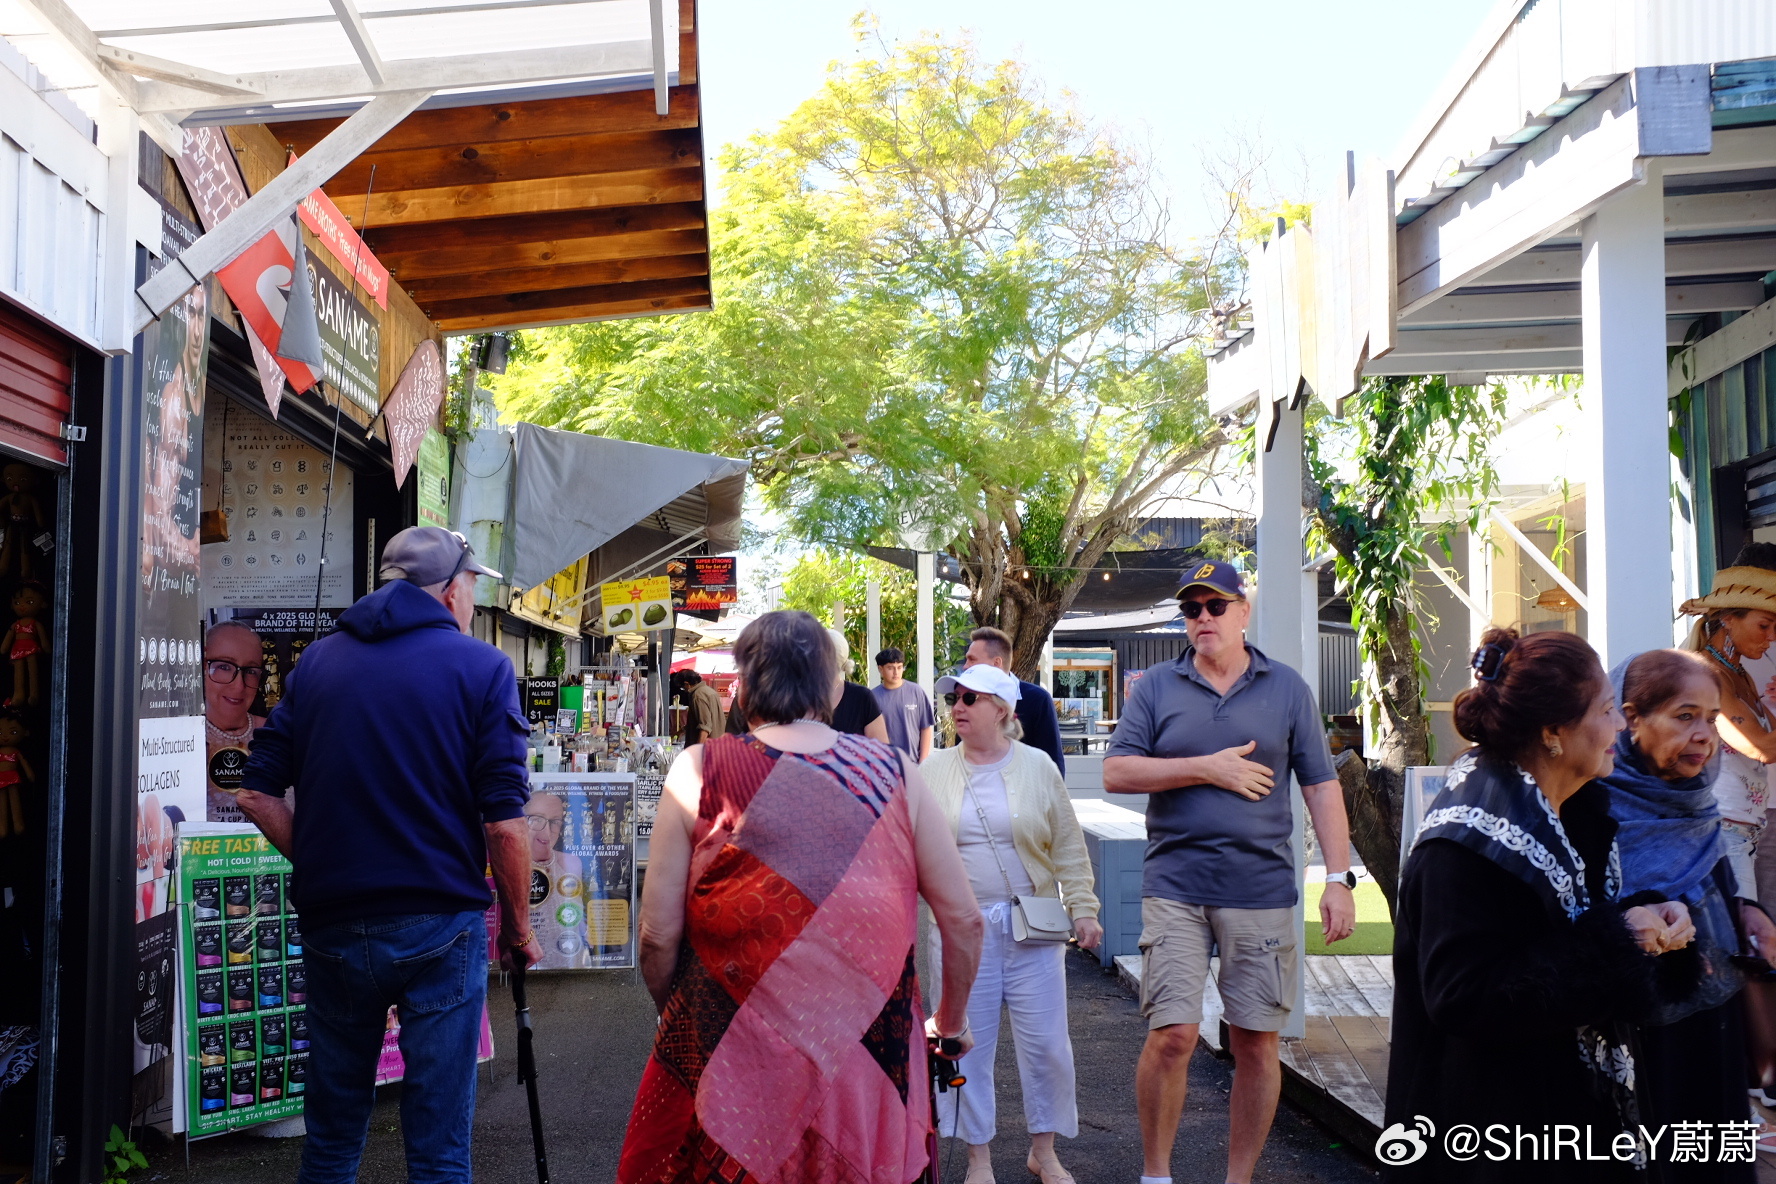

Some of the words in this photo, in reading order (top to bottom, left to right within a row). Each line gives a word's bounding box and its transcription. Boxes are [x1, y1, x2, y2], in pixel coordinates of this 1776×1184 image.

[318, 277, 369, 362] SANAME
[172, 485, 194, 512] Strength
[173, 514, 190, 536] Stress
[160, 568, 180, 592] Brain
[185, 573, 196, 600] Gut
[262, 612, 268, 620] 4
[279, 612, 296, 620] 2025
[150, 700, 179, 709] SANAME.COM
[530, 710, 541, 719] $1
[142, 735, 195, 757] Multi-Structured
[182, 838, 220, 856] FREE
[207, 858, 224, 867] HOT
[231, 857, 251, 865] COLD
[258, 855, 282, 864] SWEET
[203, 1067, 223, 1075] CHICKEN
[245, 1110, 263, 1120] STAY
[264, 1105, 295, 1117] HEALTHY
